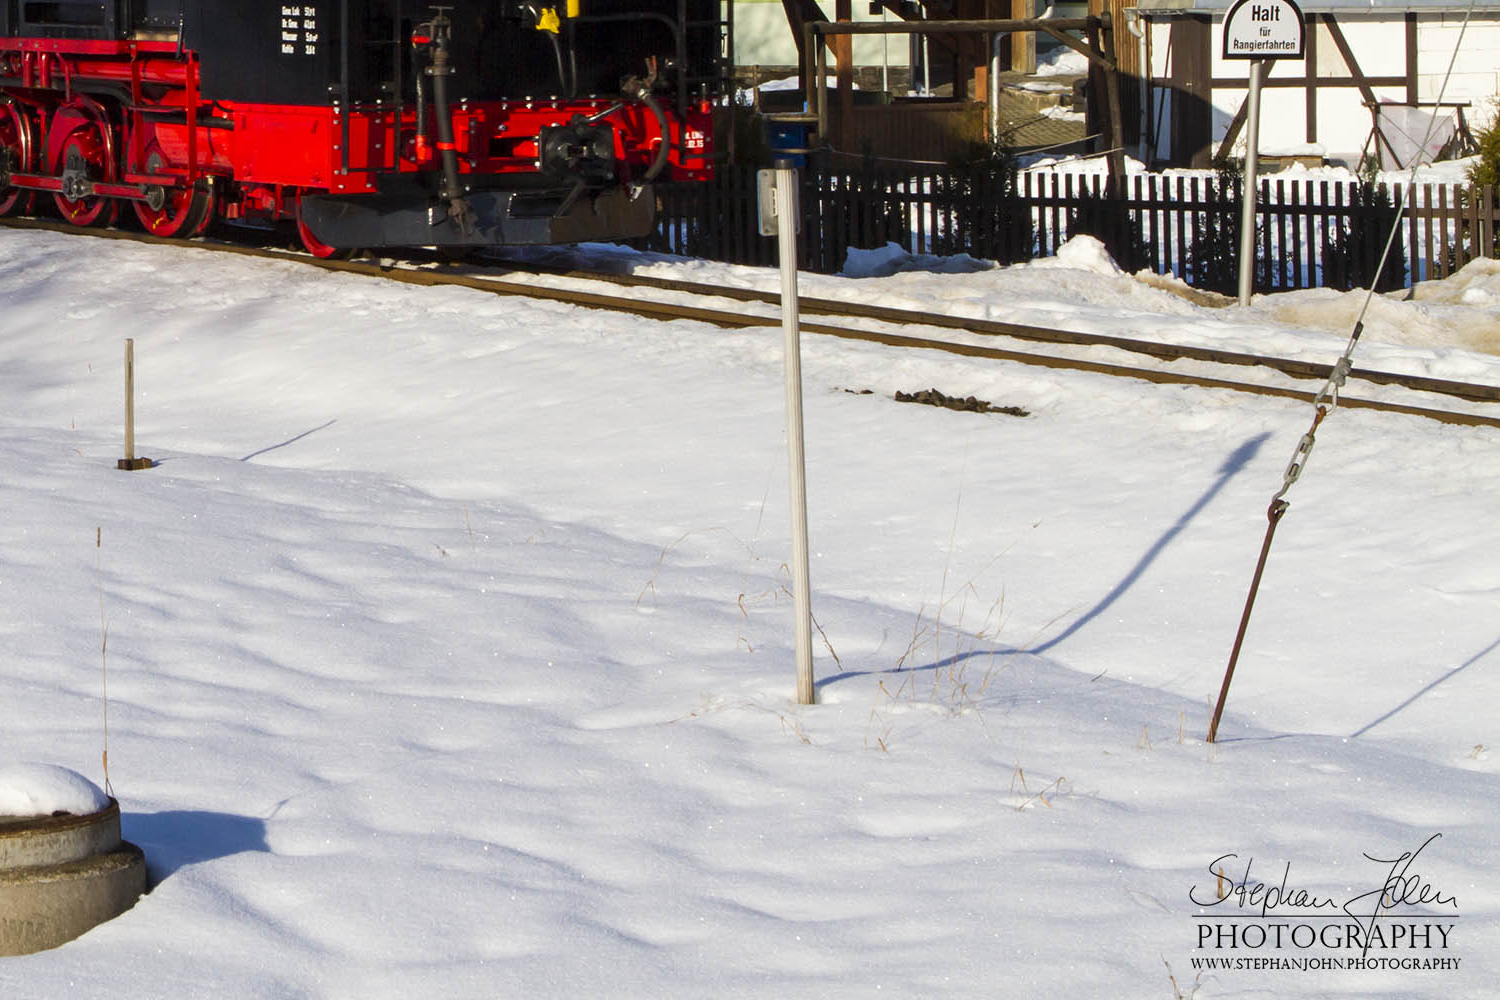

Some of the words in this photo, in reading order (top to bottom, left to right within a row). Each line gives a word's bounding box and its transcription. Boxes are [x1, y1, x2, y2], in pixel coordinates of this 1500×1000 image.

[1251, 4, 1281, 22] Halt
[1259, 26, 1271, 38] für
[1233, 37, 1296, 52] Rangierfahrten
